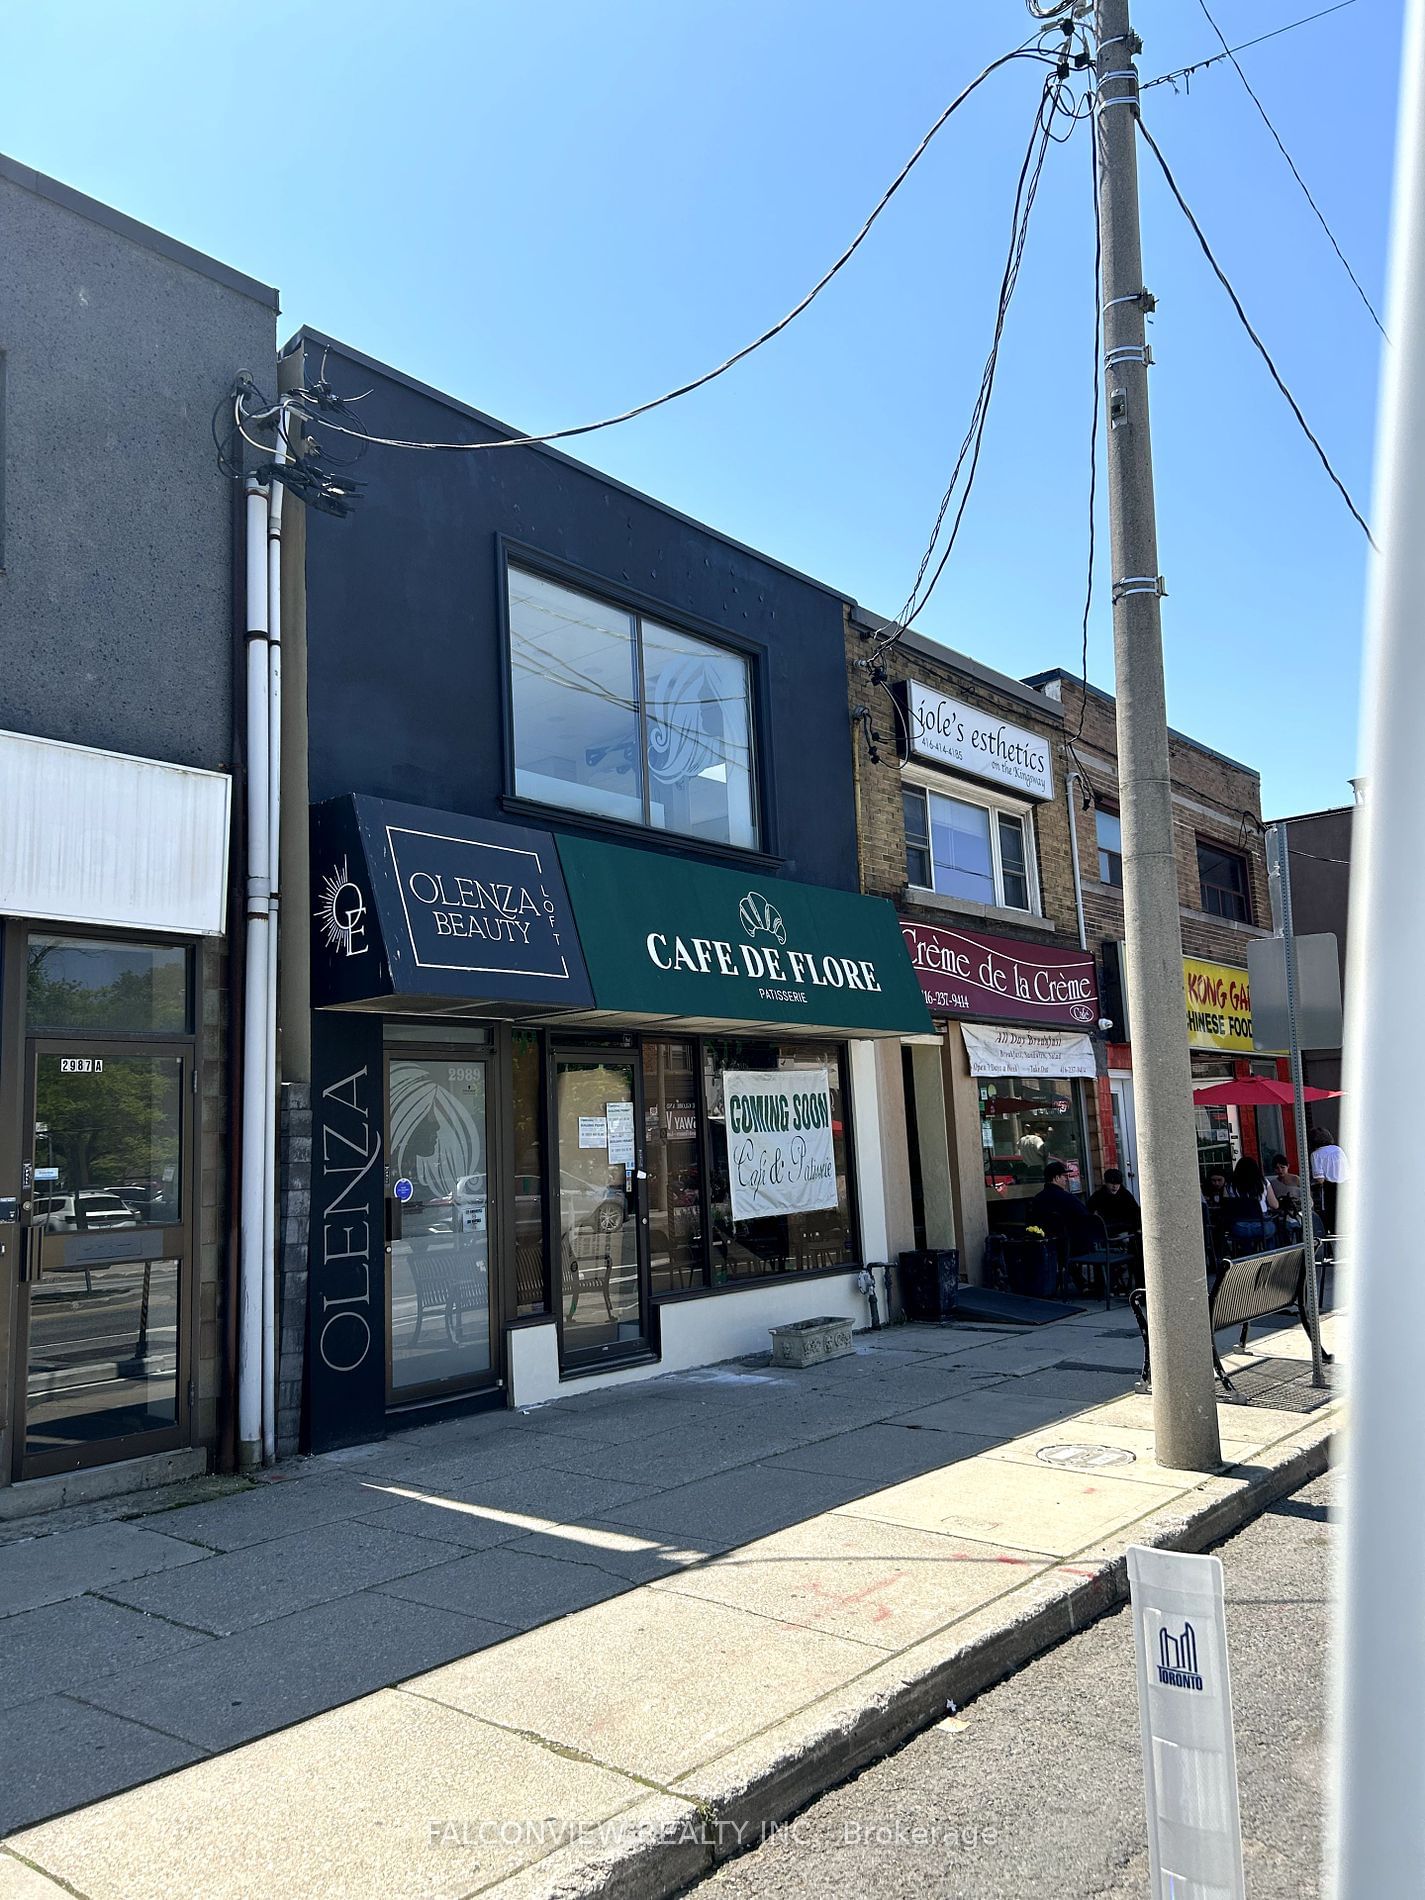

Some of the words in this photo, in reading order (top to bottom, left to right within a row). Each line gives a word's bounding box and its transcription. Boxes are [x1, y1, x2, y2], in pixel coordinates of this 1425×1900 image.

[972, 726, 1045, 773] esthetics
[991, 761, 1001, 771] on
[1002, 761, 1012, 776] the
[1013, 767, 1046, 792] Kingsway
[409, 872, 542, 919] OLENZA
[432, 911, 531, 944] BEAUTY
[540, 884, 560, 946] LOFT
[646, 932, 739, 976] CAFE
[738, 943, 787, 982] DE
[787, 950, 882, 993] FLORE
[979, 954, 1008, 992] de
[1013, 964, 1032, 1000] la
[1034, 971, 1092, 1003] Crème
[758, 987, 809, 1004] PATISSERIE
[921, 990, 970, 1009] 16-237-9414
[1187, 972, 1228, 1009] KONG
[995, 1031, 1009, 1044] All
[1010, 1032, 1026, 1048] Day
[1027, 1034, 1062, 1049] Breakfast
[1186, 1010, 1226, 1035] HINESE
[448, 1067, 481, 1082] 2989
[729, 1094, 790, 1134] COMING
[792, 1092, 830, 1131] SOON
[769, 1147, 785, 1185] &
[320, 1064, 382, 1372] OLENZA
[1157, 1666, 1204, 1691] TORONTO
